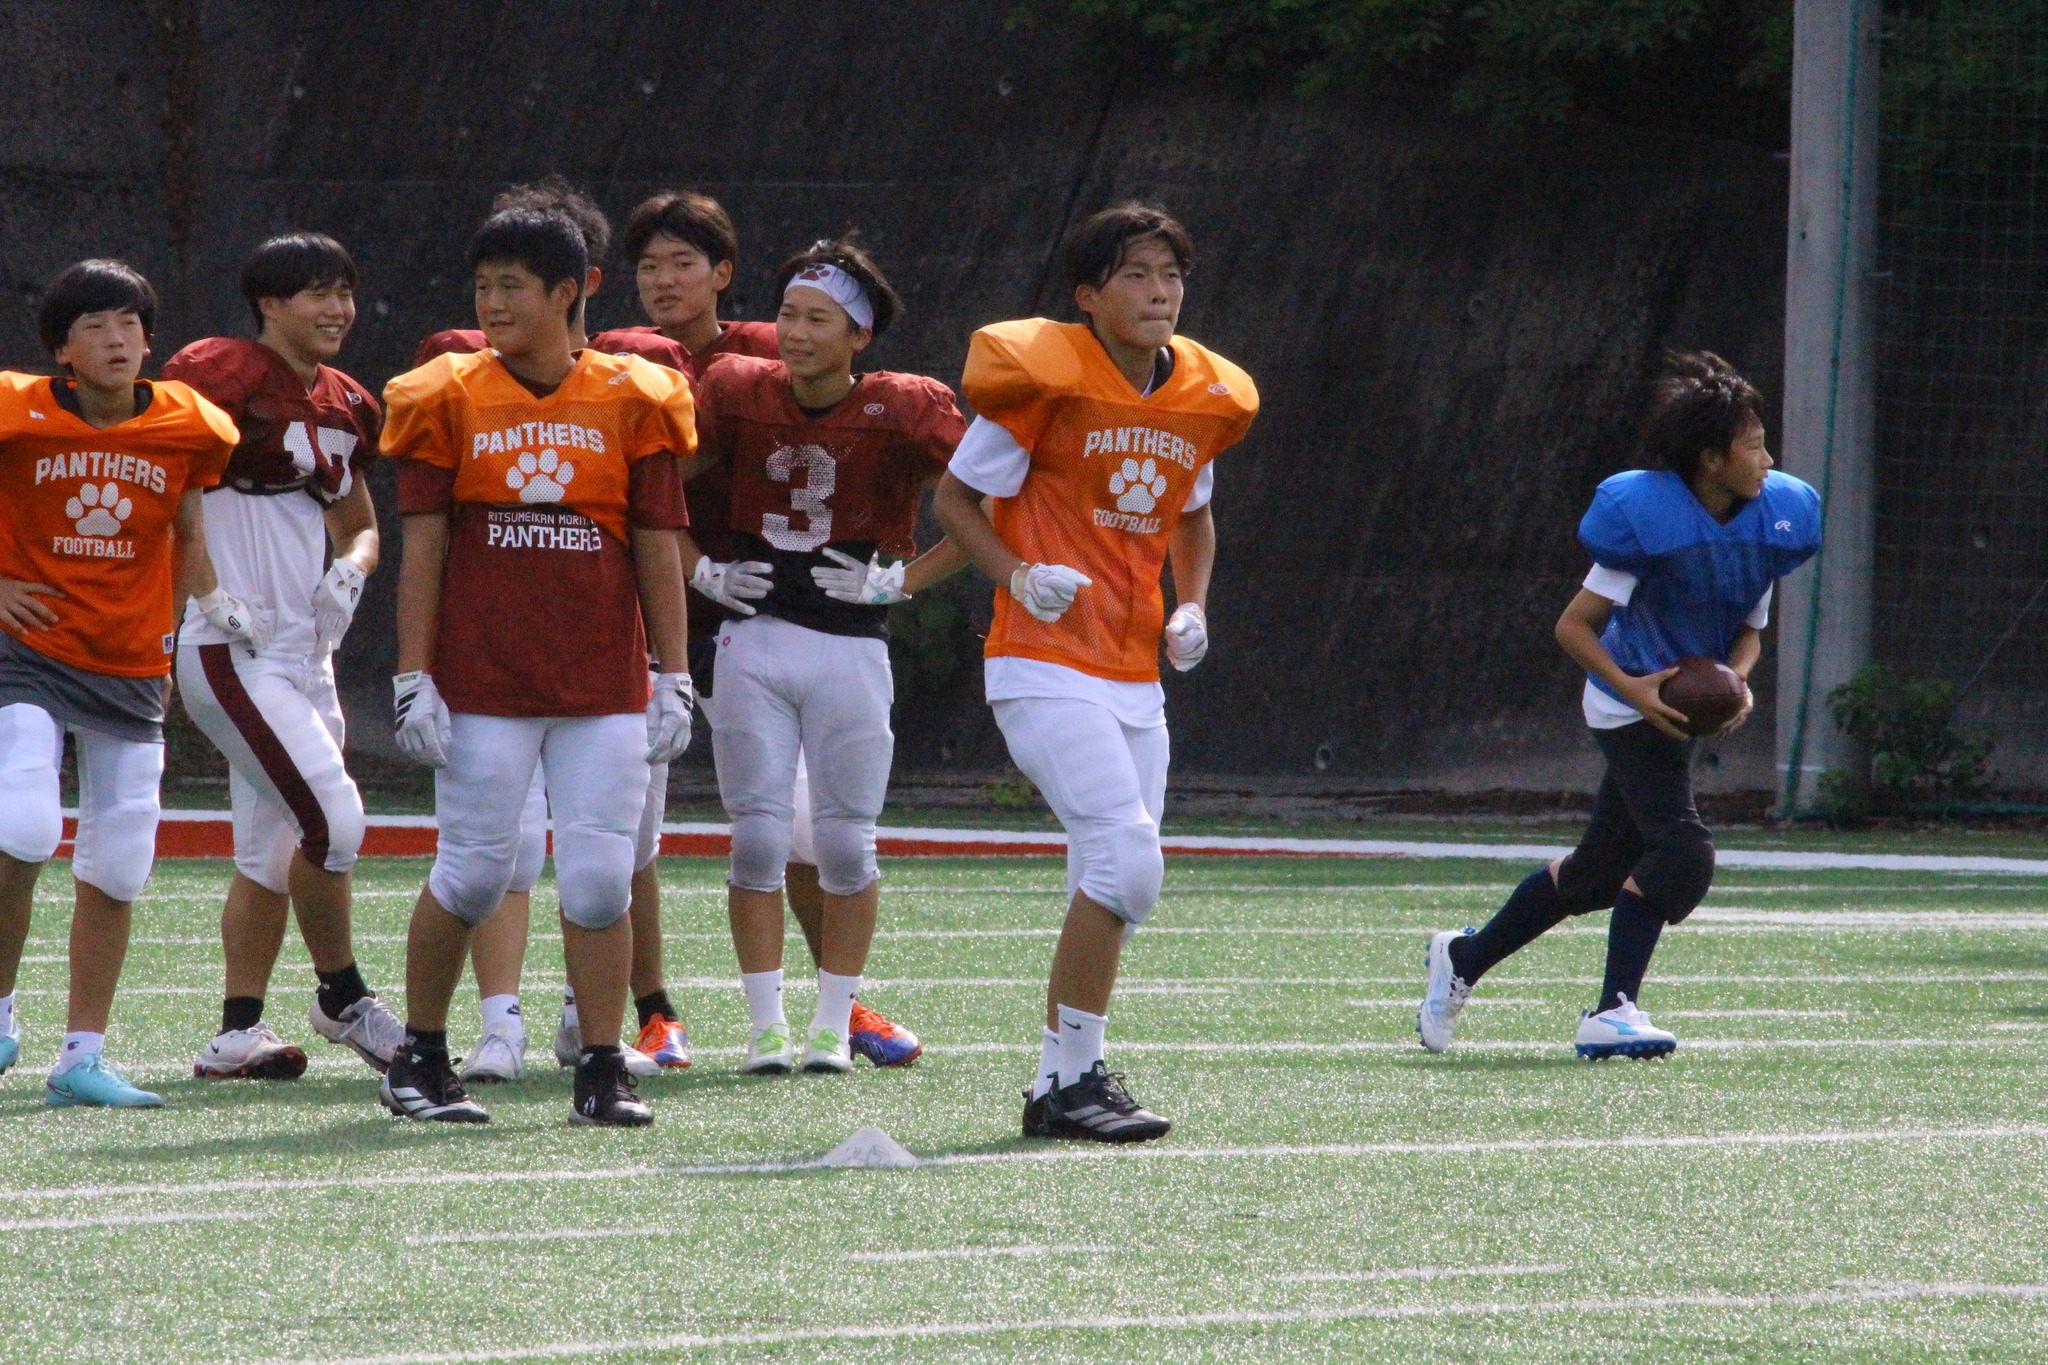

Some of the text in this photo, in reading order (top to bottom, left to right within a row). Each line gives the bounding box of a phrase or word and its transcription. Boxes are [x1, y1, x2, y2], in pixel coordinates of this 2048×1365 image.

[473, 421, 605, 459] PANTHERS
[1083, 427, 1197, 470] PANTHERS
[35, 452, 166, 493] PANTHERS
[762, 445, 836, 552] 3
[488, 511, 598, 527] RITSUMEIKAN MORIY
[1093, 508, 1162, 533] FOOTBALL
[53, 536, 135, 558] FOOTBALL
[487, 524, 602, 551] PANTHERS
